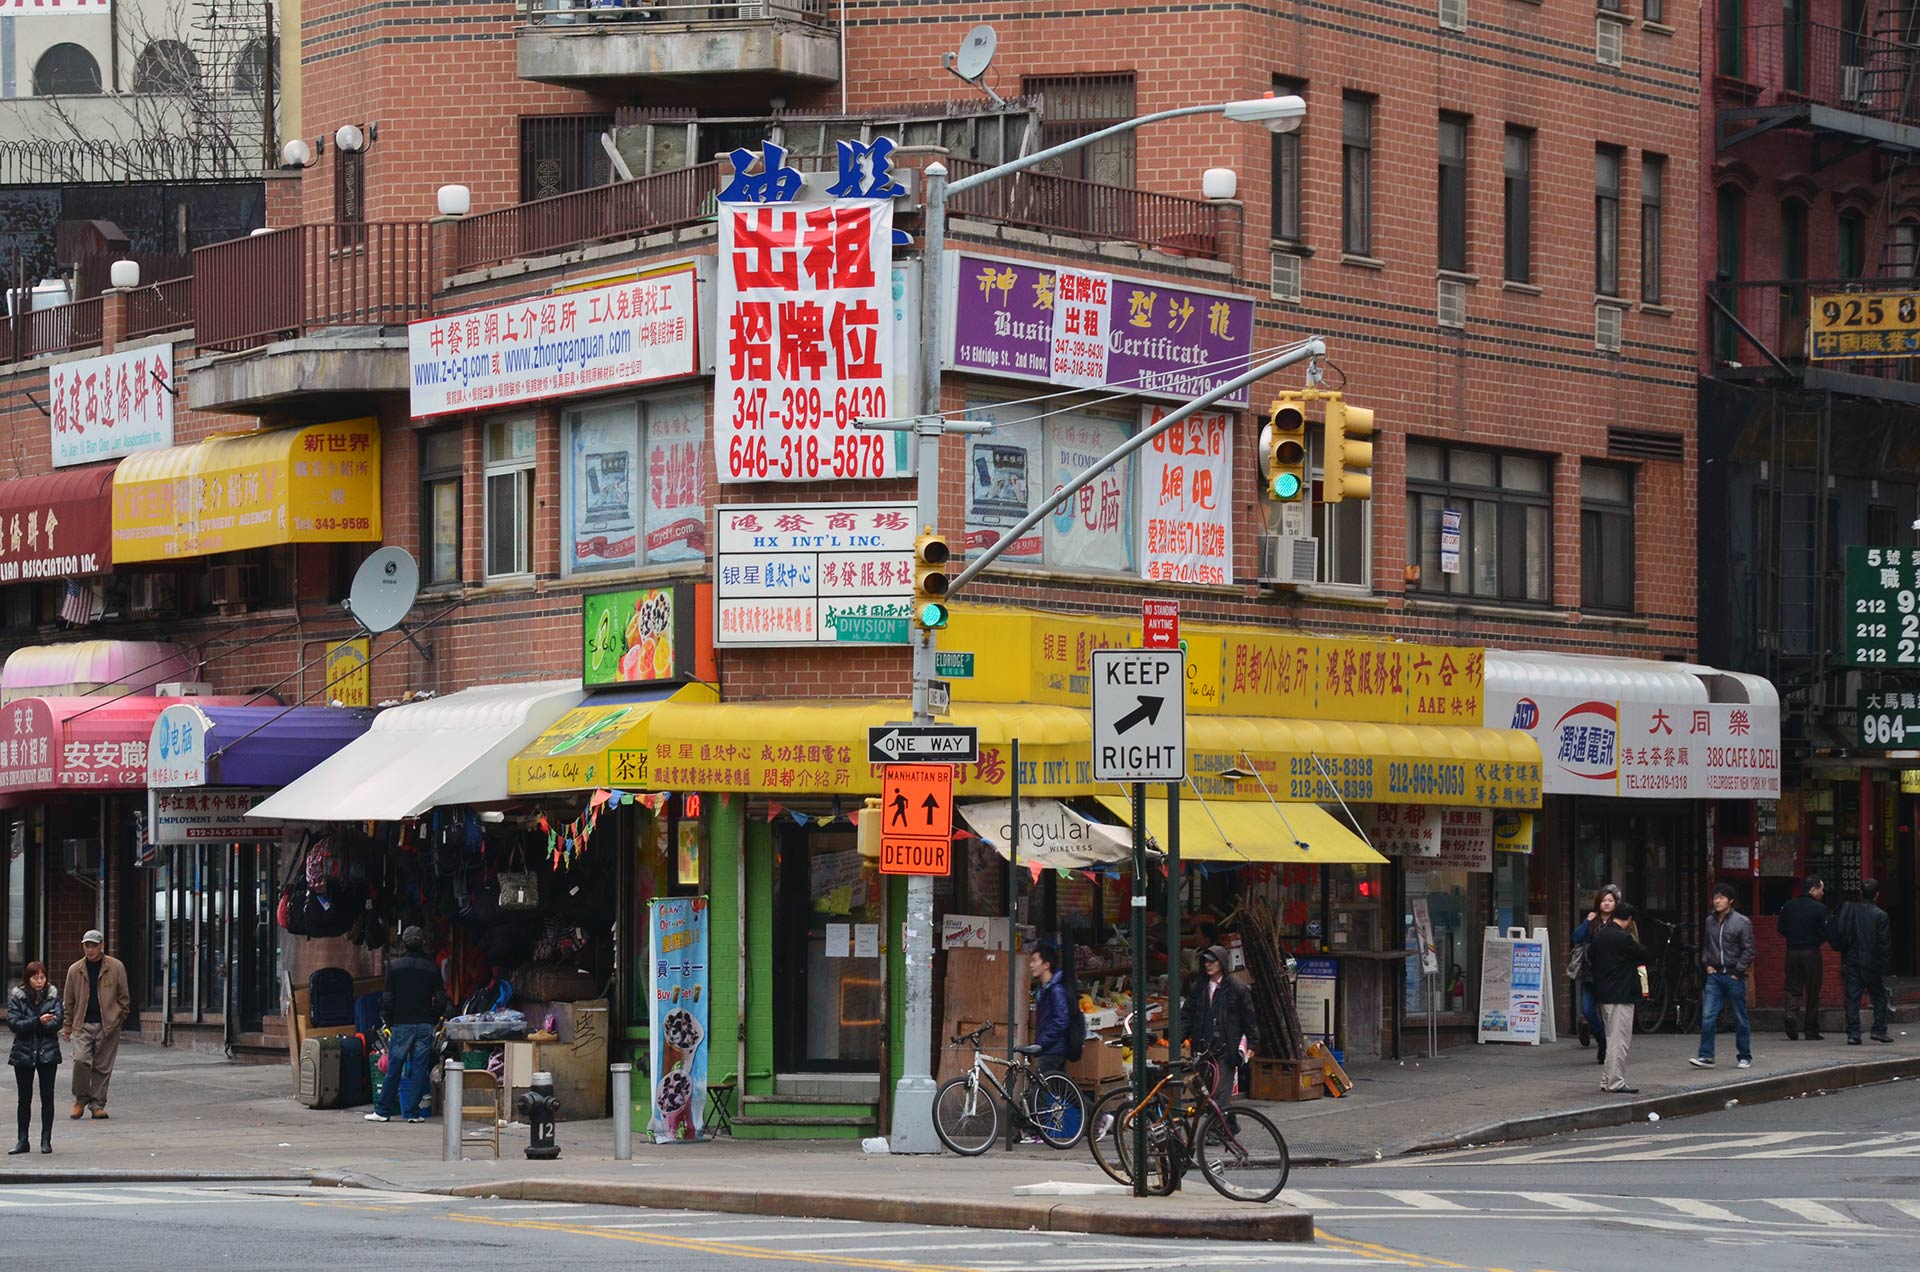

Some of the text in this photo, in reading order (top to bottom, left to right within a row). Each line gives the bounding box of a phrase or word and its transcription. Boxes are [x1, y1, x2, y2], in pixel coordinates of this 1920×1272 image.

[733, 207, 875, 292] 出租
[1059, 273, 1107, 305] 招牌位
[430, 284, 672, 356] 中餐館網上介紹所 工人免費找工
[1065, 307, 1099, 336] 出租
[1822, 298, 1884, 327] 925
[729, 300, 882, 381] 招牌位
[1055, 338, 1104, 360] 347-399-6430
[1109, 329, 1209, 366] Certificate
[415, 353, 490, 387] www.z-c-g.com
[492, 352, 501, 375] 或
[972, 346, 999, 367] Eldridge
[1001, 350, 1011, 366] St.
[1015, 352, 1028, 369] 2nd
[1029, 352, 1048, 373] Floor,
[1054, 358, 1103, 379] 646-318-5878
[732, 386, 886, 430] 347-399-6430
[304, 434, 370, 452] 新世界
[729, 434, 884, 478] 646-318-5878
[1160, 463, 1216, 511] 網吧
[238, 510, 273, 526] AGENCY
[753, 534, 885, 547] HX INT'L INC.
[22, 555, 78, 578] ASSOCIATION
[80, 553, 99, 573] INC.
[823, 561, 912, 588] 鴻發服務社
[1144, 604, 1177, 616] NO STANDING
[1856, 590, 1920, 614] 212 9
[840, 619, 896, 633] DIVISION
[1148, 619, 1174, 630] ANYTIME
[1856, 623, 1887, 638] 212
[936, 653, 965, 668] ELDRIDGE
[1856, 638, 1920, 663] 212 2
[1106, 662, 1170, 685] KEEP
[1232, 643, 1308, 697] 閩都介紹所
[1325, 647, 1403, 697] 鴻發服務社
[1412, 651, 1484, 690] 六合彩
[1417, 697, 1446, 714] AAE
[1867, 692, 1920, 709] 大馬職
[14, 706, 34, 734] 安安
[1649, 708, 1751, 736] 大同樂
[63, 741, 147, 769] 安安職
[761, 744, 851, 763] 成功集團電信
[885, 738, 963, 751] ONE WAY
[1103, 746, 1176, 770] RIGHT
[1621, 747, 1689, 766] 港式茶餐廳
[1706, 747, 1778, 769] 388 CAFE & DELI
[58, 771, 109, 784] TEL:
[548, 764, 559, 778] Tea
[563, 763, 579, 782] Cafe
[762, 768, 850, 788] 閩都介紹所
[887, 770, 949, 783] MANHATTAN BR
[1018, 761, 1037, 784] HX
[1043, 757, 1071, 784] INT'L
[1389, 762, 1465, 796] 212-966-5053
[159, 814, 246, 825] EMPLOYMENT AGENCY
[1000, 814, 1092, 847] cngular
[885, 845, 945, 866] DETOUR
[1049, 845, 1093, 853] WIRELESS
[657, 960, 703, 978] 買一送一
[657, 989, 671, 1002] Buy
[539, 1122, 554, 1140] 12
